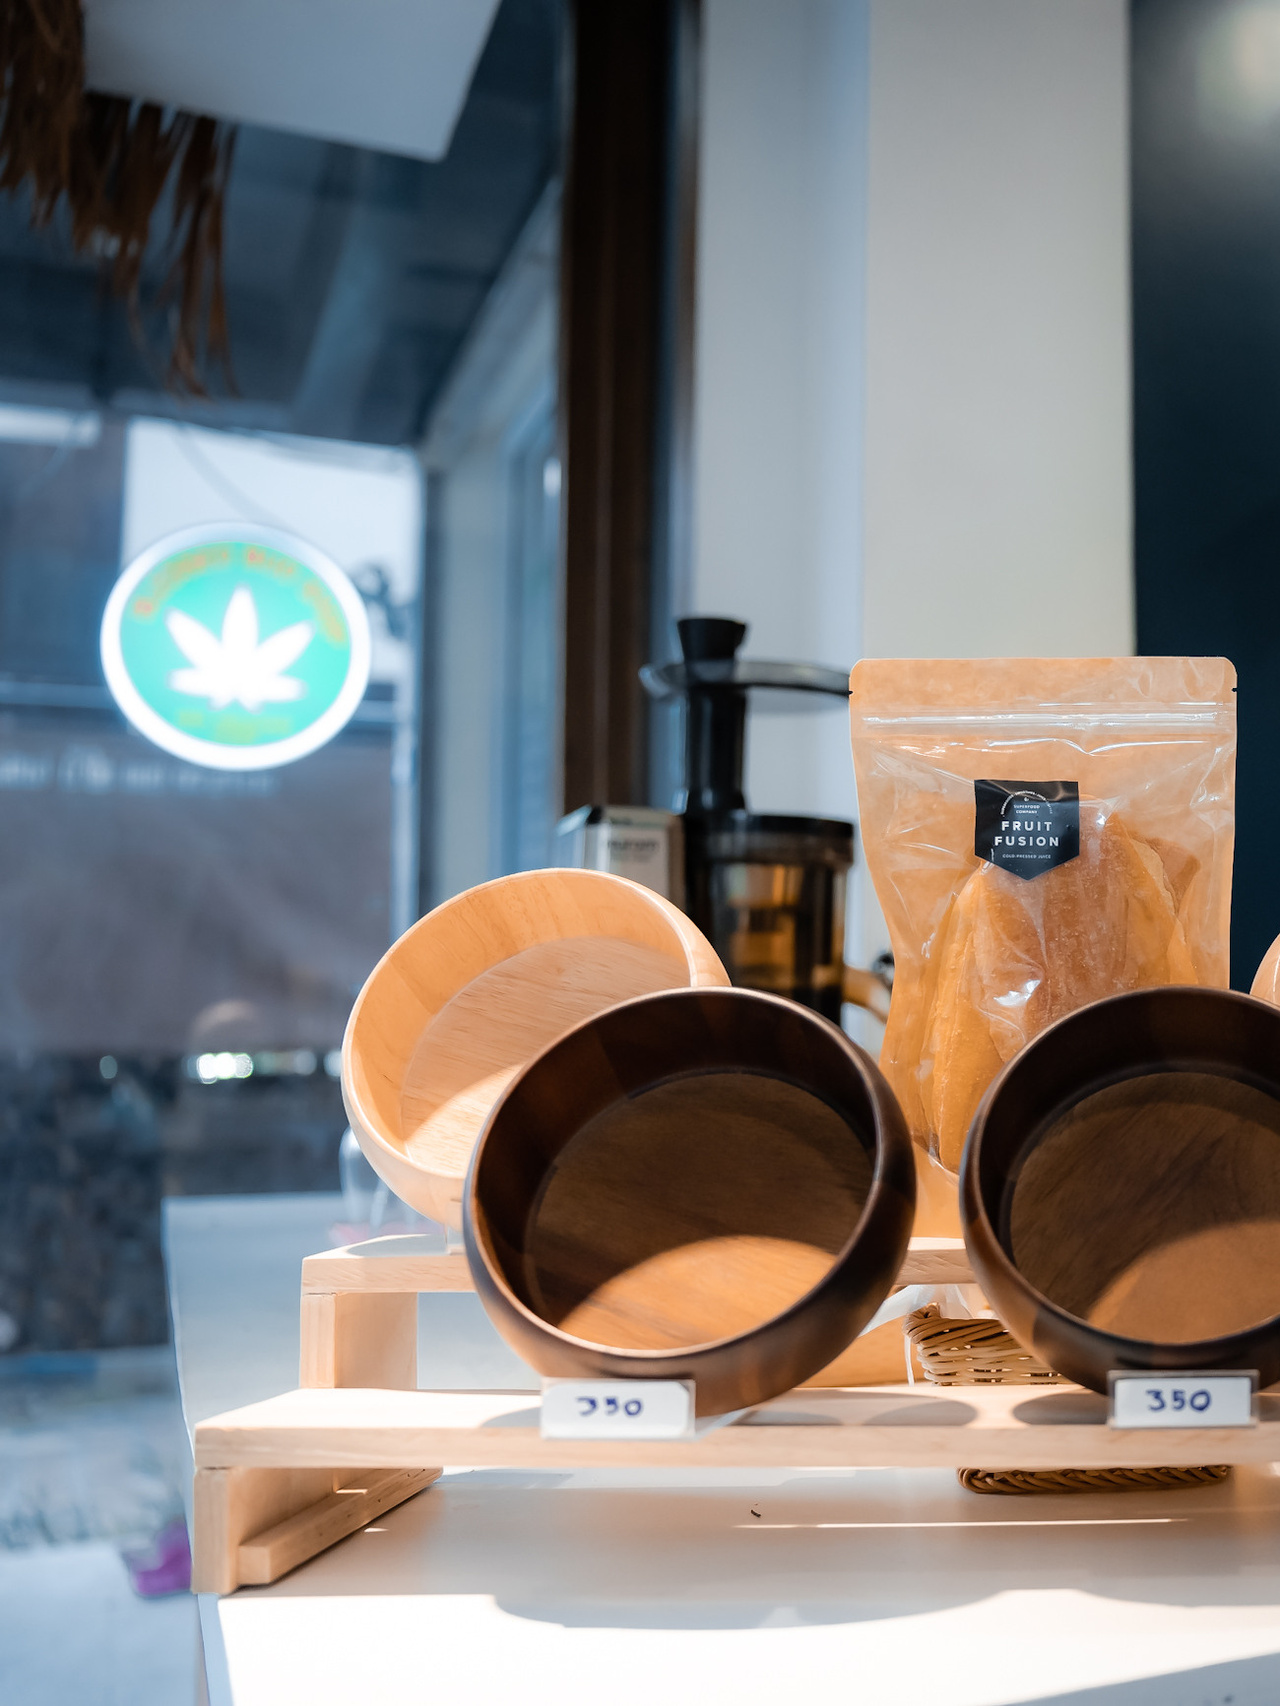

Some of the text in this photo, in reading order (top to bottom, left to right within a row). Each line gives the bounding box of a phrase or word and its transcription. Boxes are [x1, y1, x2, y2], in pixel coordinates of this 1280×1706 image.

[1001, 820, 1053, 831] FRUIT
[994, 836, 1059, 847] FUSION
[1146, 1389, 1211, 1412] 350
